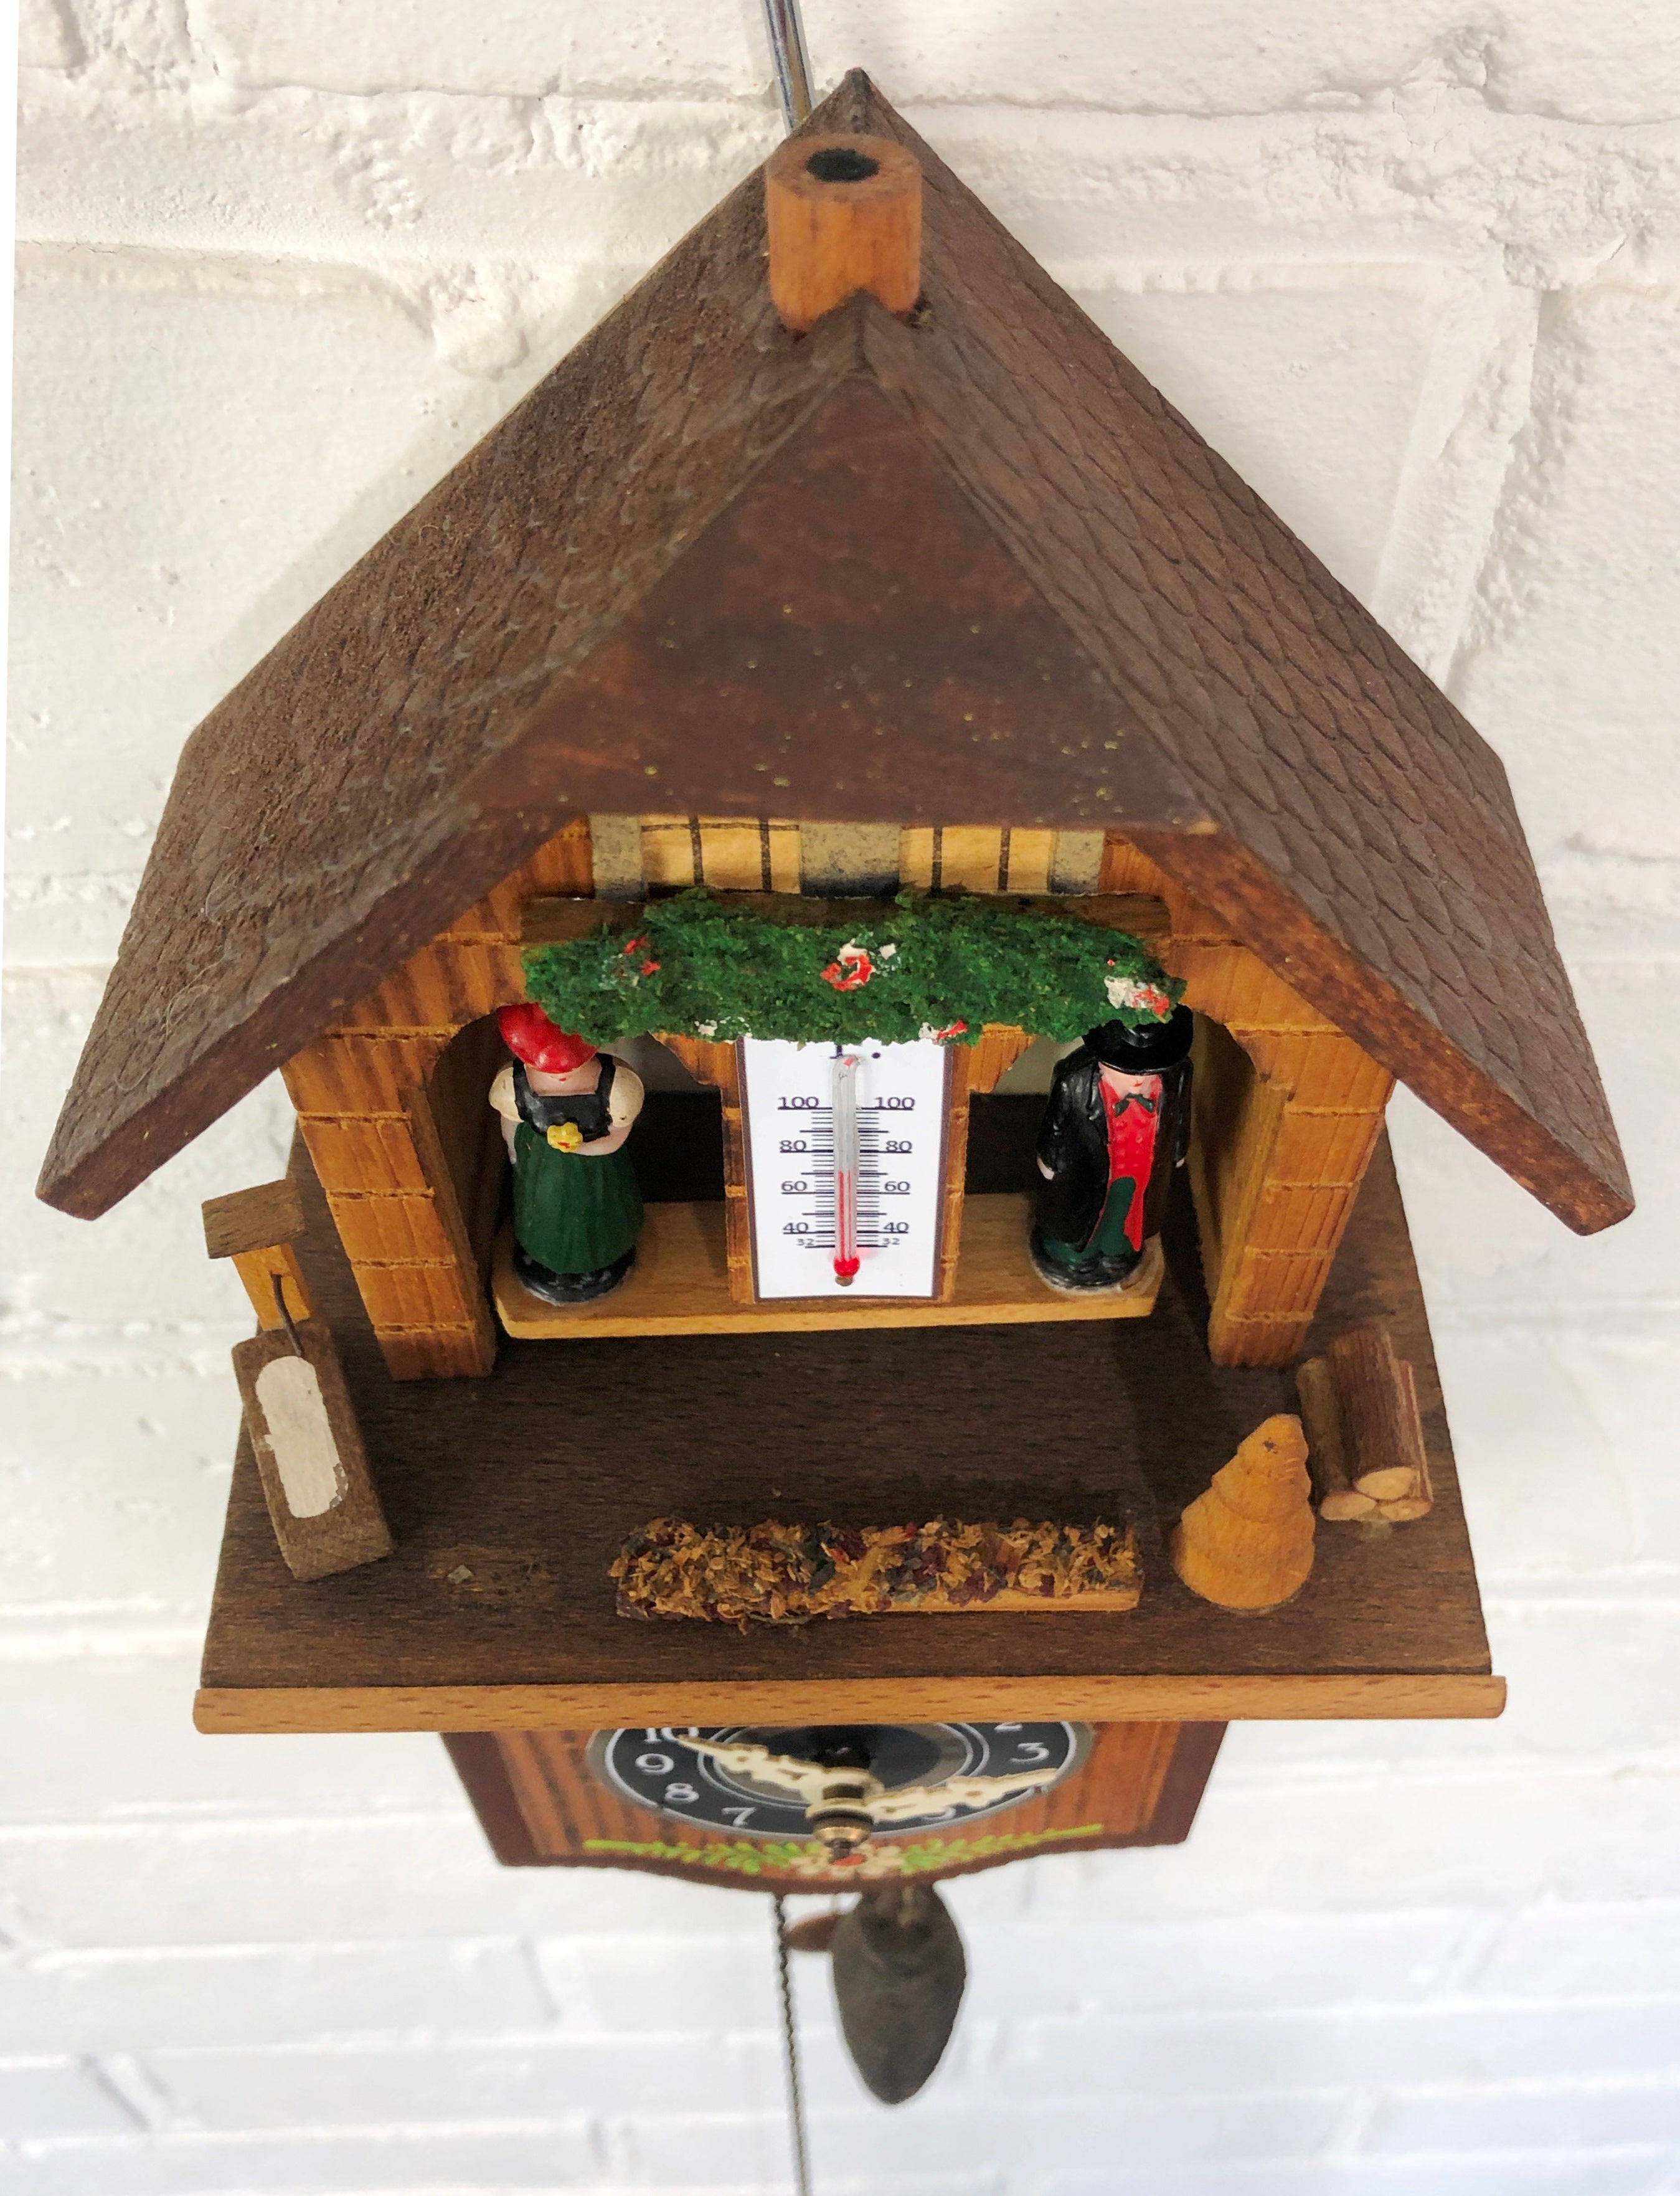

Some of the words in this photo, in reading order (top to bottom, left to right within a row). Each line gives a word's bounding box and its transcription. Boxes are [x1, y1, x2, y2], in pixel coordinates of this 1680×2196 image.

[778, 1096, 819, 1109] 100
[874, 1097, 915, 1110] 100
[779, 1140, 806, 1152] 80
[885, 1140, 912, 1153] 80
[781, 1181, 807, 1191] 60
[884, 1181, 910, 1191] 60
[783, 1222, 808, 1233] 40
[883, 1222, 909, 1233] 40
[1009, 1743, 1049, 1764] 3
[635, 1753, 674, 1775] 9
[664, 1783, 699, 1804] 8
[721, 1807, 757, 1827] 7
